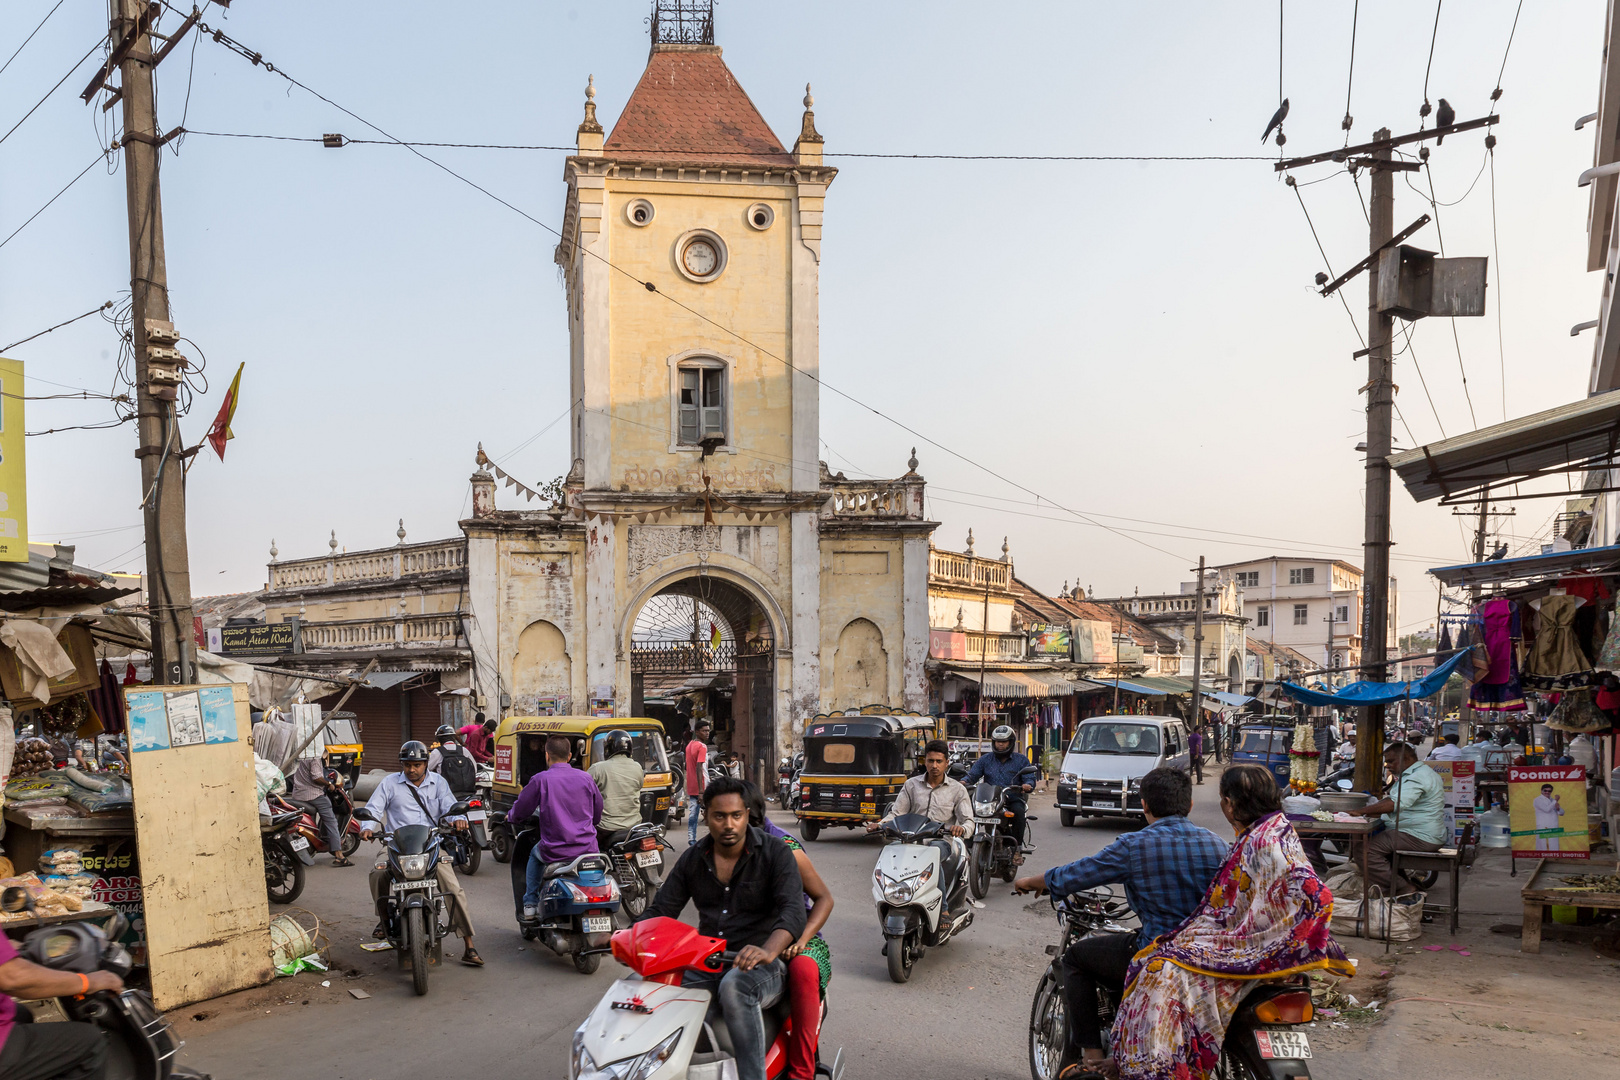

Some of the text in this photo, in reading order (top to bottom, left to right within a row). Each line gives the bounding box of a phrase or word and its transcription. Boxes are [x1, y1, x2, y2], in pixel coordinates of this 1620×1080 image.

[223, 633, 293, 647] Kamal Attar Wala
[1510, 770, 1566, 780] Poomer
[1268, 1032, 1301, 1044] KA22
